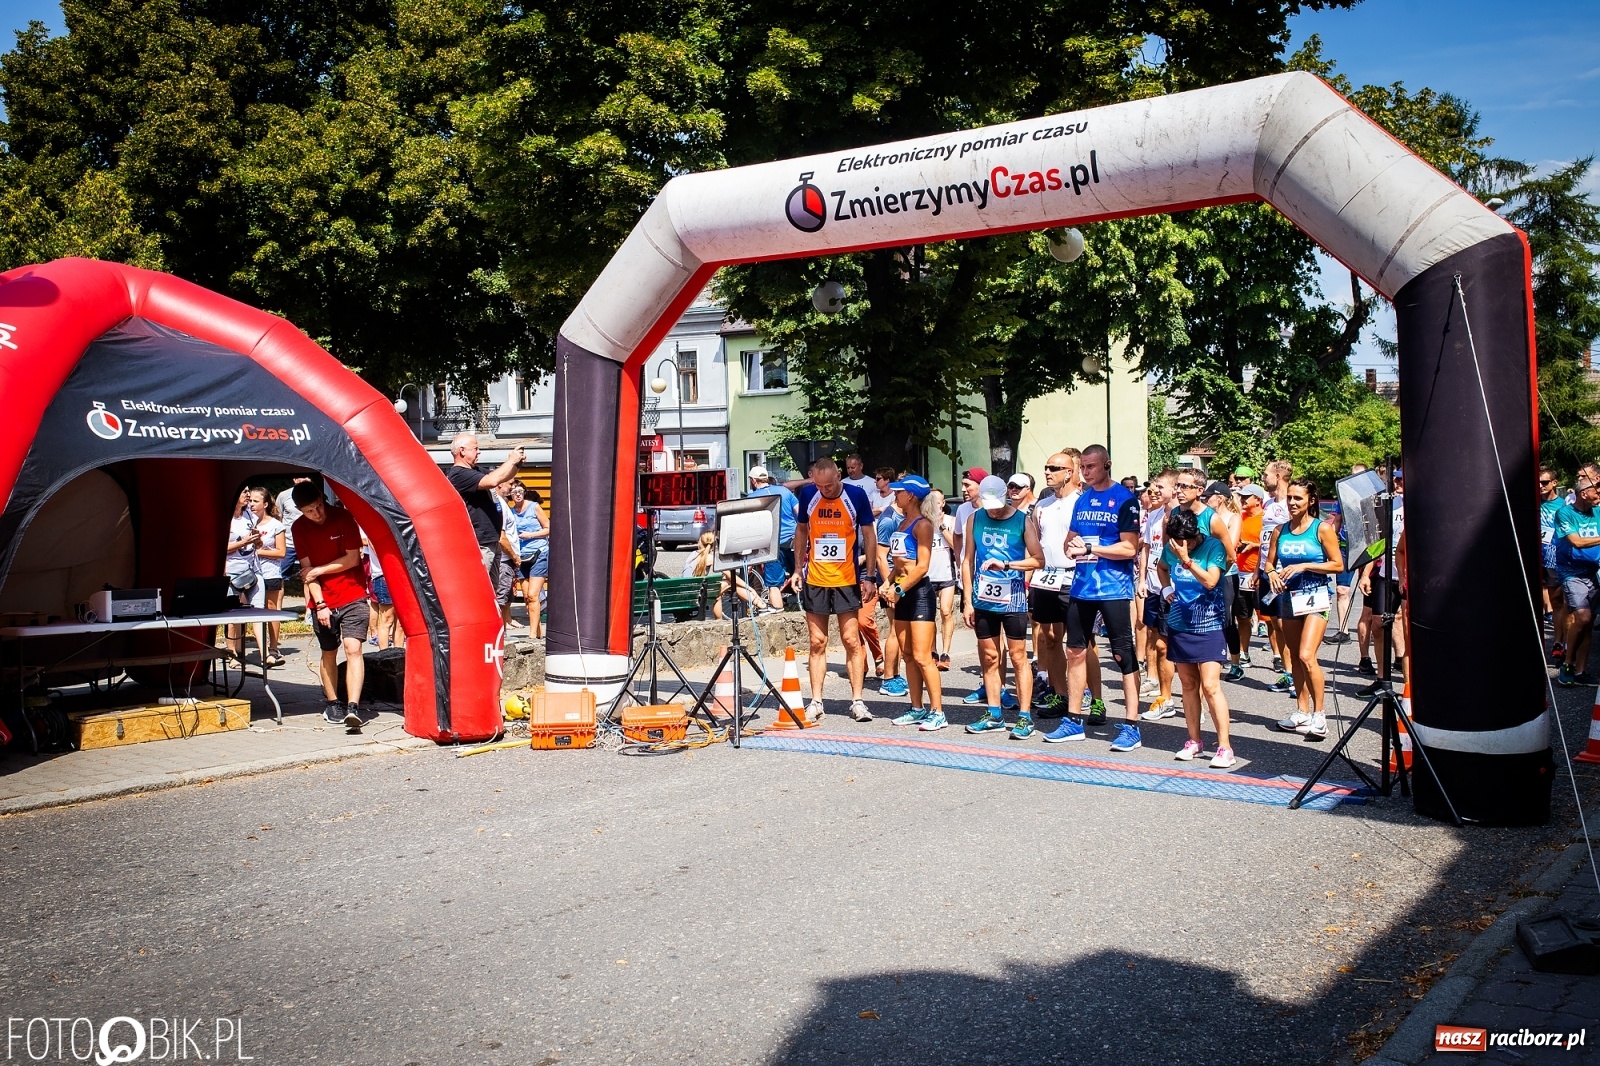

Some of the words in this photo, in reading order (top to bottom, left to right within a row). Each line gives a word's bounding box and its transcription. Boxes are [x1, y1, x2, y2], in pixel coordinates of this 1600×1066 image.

[837, 144, 957, 173] Elektroniczny
[959, 131, 1028, 158] pomiar
[1032, 121, 1088, 141] czasu
[830, 149, 1101, 221] ZmierzymyCzas.pl
[121, 400, 211, 417] Elektroniczny
[215, 405, 258, 417] pomiar
[261, 408, 295, 416] czasu
[124, 418, 312, 445] ZmierzymyCzas.pl
[818, 508, 833, 519] ULC
[821, 545, 838, 557] 38
[1040, 574, 1057, 586] 45
[984, 583, 1003, 598] 33
[1306, 595, 1316, 608] 4
